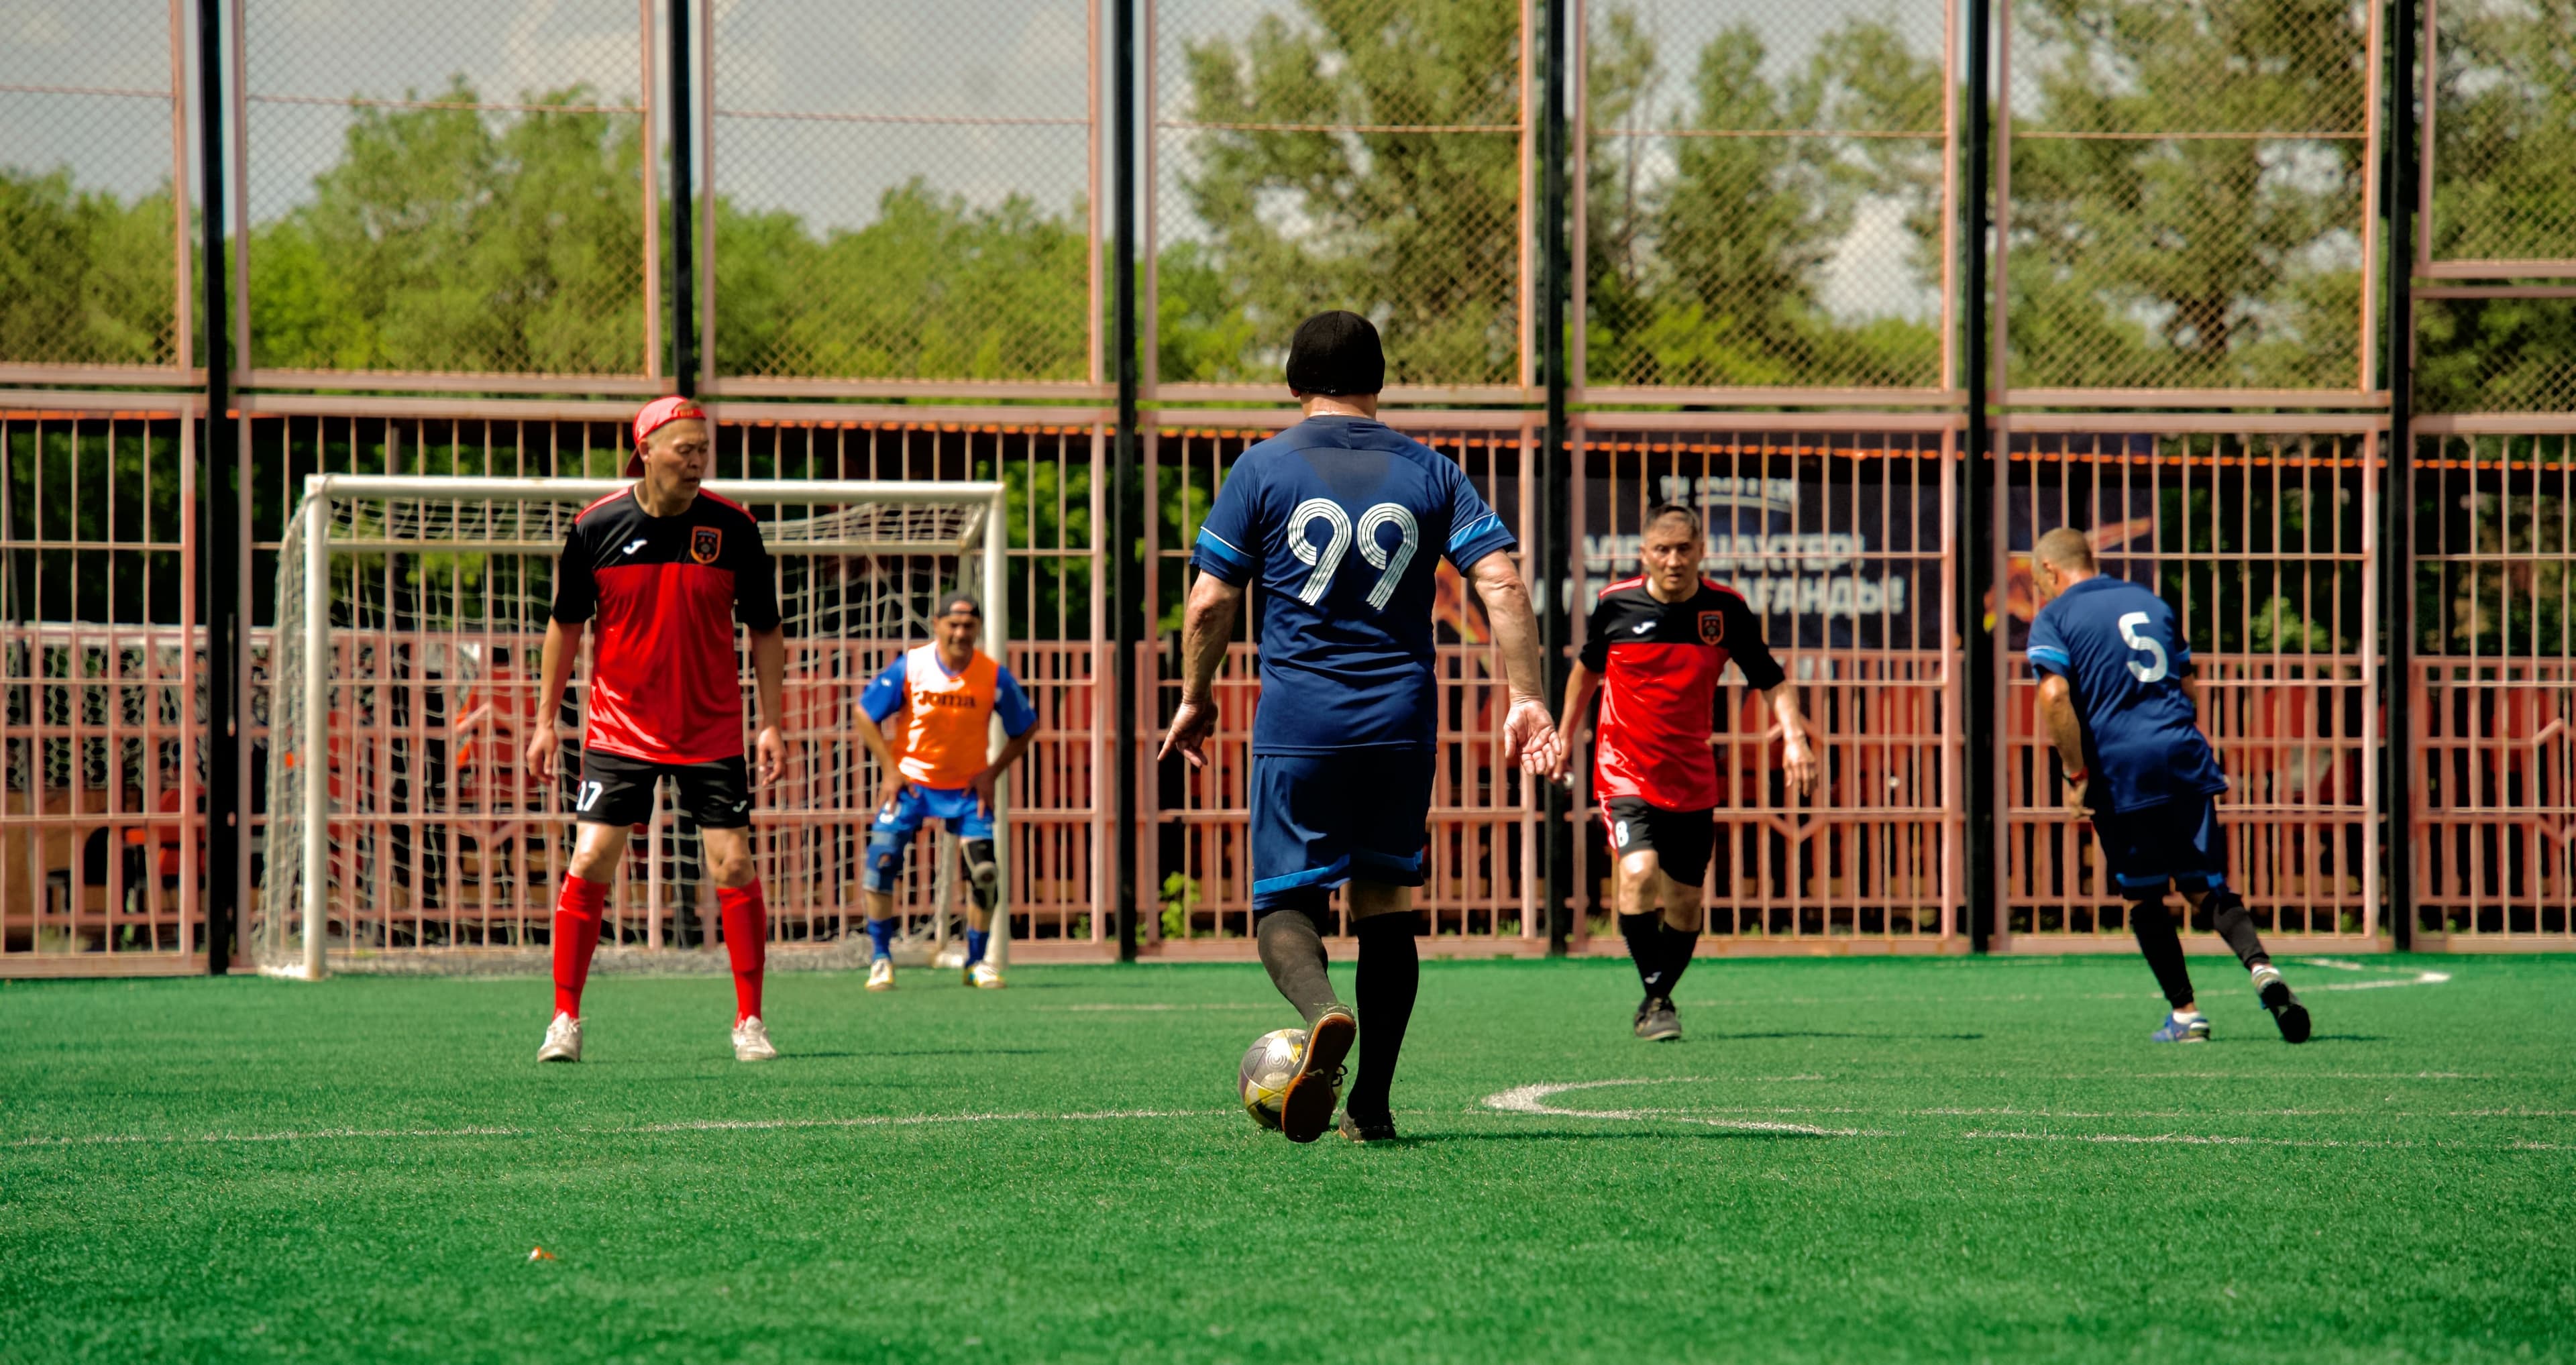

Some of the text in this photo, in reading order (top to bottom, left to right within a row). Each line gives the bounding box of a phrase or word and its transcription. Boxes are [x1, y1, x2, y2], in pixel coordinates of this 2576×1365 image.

[1287, 497, 1419, 610] 99
[2118, 611, 2168, 683] 5
[576, 780, 602, 812] 17
[1615, 820, 1629, 848] 8
